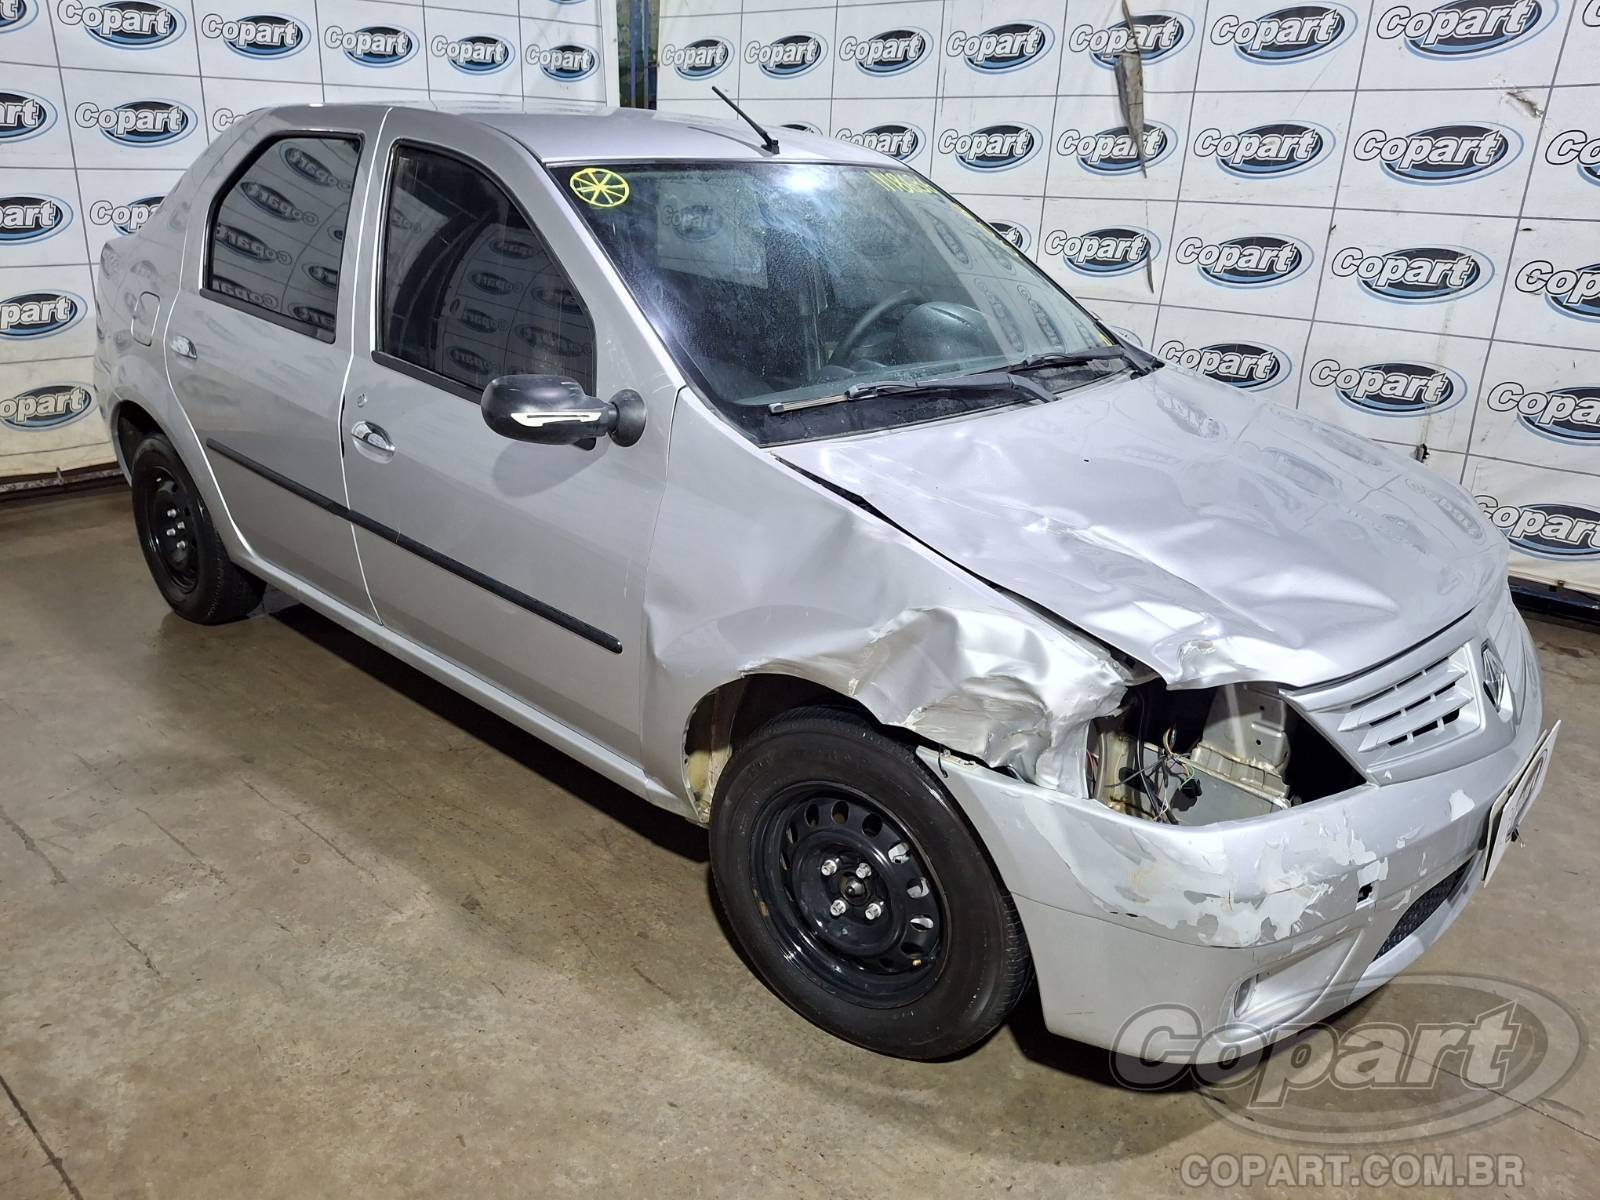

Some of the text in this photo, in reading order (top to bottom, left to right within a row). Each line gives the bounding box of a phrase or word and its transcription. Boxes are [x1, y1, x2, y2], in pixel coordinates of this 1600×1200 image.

[57, 0, 170, 35] Copart
[202, 14, 297, 47] Copart
[1210, 9, 1340, 53] Copart
[1376, 0, 1540, 47] Copart
[325, 25, 409, 56] Copart
[431, 35, 505, 63] Copart
[744, 37, 822, 68] Copart
[839, 32, 924, 66] Copart
[946, 26, 1042, 62] Copart
[1069, 17, 1179, 58] Copart
[525, 44, 591, 71] Copart
[661, 41, 726, 70] Copart
[75, 102, 183, 135] Copart
[938, 129, 1032, 160] Copart
[1057, 128, 1164, 164] Copat
[1194, 128, 1319, 165] Copart
[1354, 129, 1504, 170] Copart
[0, 201, 56, 228] art
[90, 200, 160, 230] Cop
[1044, 229, 1150, 263] Copart
[1176, 236, 1298, 274] Copart
[1332, 247, 1474, 287] Copart
[1515, 260, 1600, 304] Cop
[0, 296, 70, 330] part
[1158, 340, 1276, 380] Copart
[1309, 359, 1449, 403] Copart
[0, 386, 86, 422] opart
[1487, 381, 1600, 425] Copa
